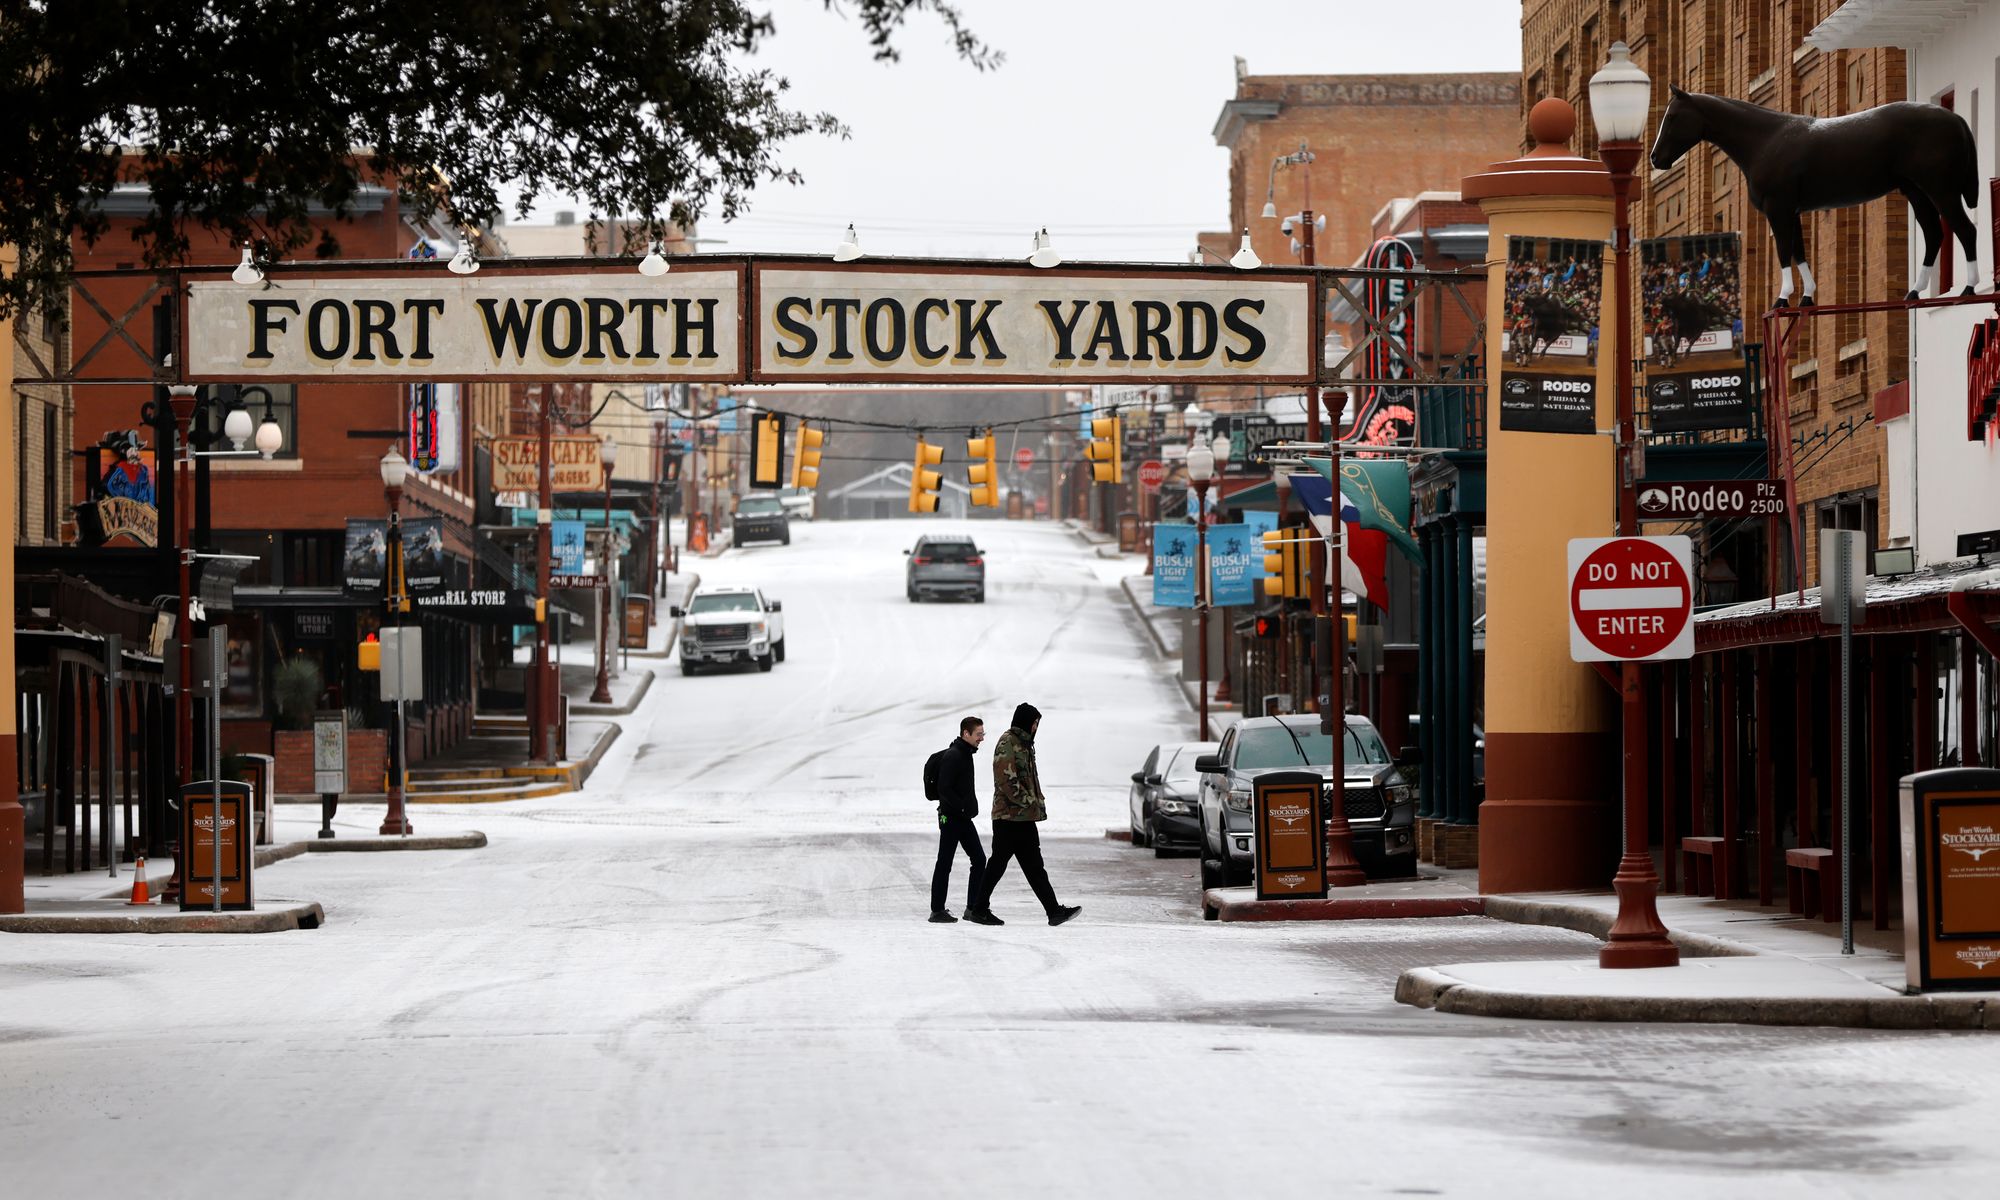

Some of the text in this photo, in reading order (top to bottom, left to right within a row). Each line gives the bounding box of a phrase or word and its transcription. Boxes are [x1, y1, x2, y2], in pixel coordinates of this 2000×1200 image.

[1300, 83, 1387, 103] BOARD
[1419, 82, 1517, 103] ROOMS
[247, 296, 719, 366] FORT WORTH
[775, 296, 1267, 367] STOCK YARDS
[1542, 381, 1593, 394] RODEO
[1691, 375, 1742, 390] RODEO
[1548, 395, 1579, 403] FRIDAY
[1698, 390, 1728, 399] FRIDAY
[1543, 403, 1592, 411] SATURDAYS
[1693, 399, 1743, 408] SATURDAYS
[551, 442, 597, 465] CAFE
[504, 470, 590, 485] STEAK URGERS
[1141, 467, 1164, 481] STOP
[1756, 482, 1777, 497] Plz
[1671, 485, 1745, 512] Rodeo
[1750, 499, 1785, 514] 2500
[1155, 556, 1193, 567] BUSCH
[1211, 555, 1250, 567] BUSCH
[1159, 567, 1187, 575] LIGHT
[1216, 566, 1244, 575] LIGHT
[1588, 561, 1673, 582] DO NOT
[561, 576, 568, 587] N
[571, 576, 594, 587] Main
[417, 590, 506, 606] GENERAL STORE
[297, 615, 332, 625] GENERAL
[1598, 615, 1666, 636] ENTER
[302, 625, 327, 634] STORE
[1269, 808, 1310, 816] STOCKYARDS
